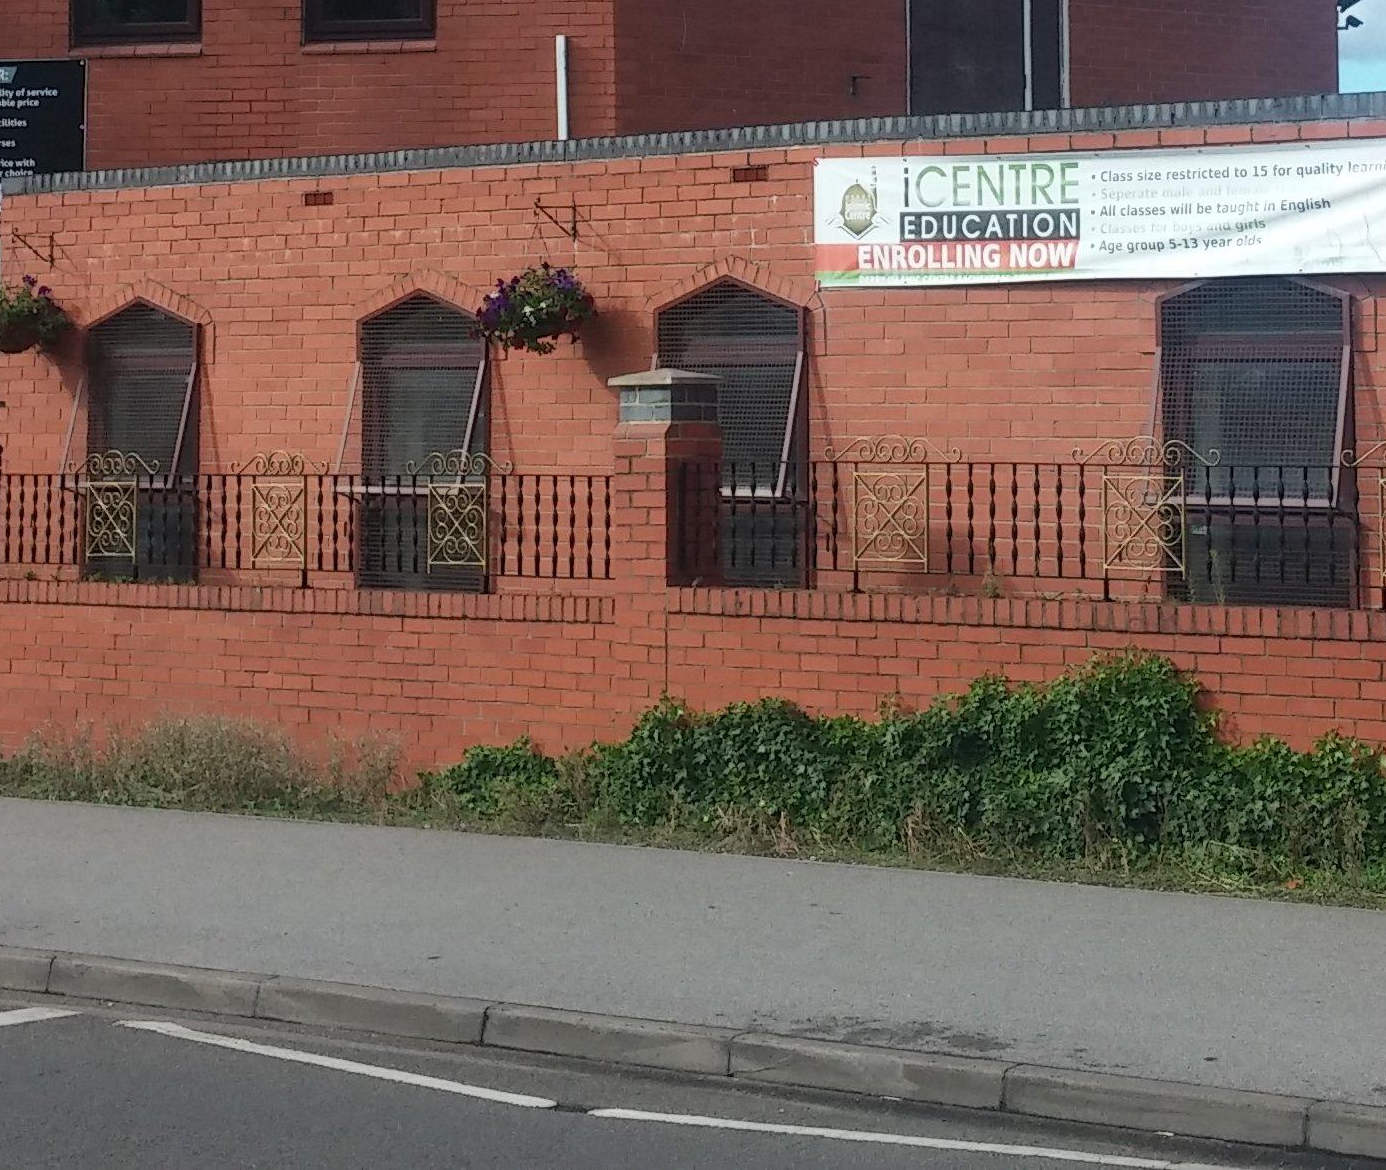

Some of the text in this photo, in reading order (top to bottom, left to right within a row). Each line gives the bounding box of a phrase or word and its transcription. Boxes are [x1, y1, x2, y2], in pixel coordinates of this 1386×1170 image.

[15, 87, 25, 97] of
[26, 87, 58, 97] service
[17, 98, 40, 109] price
[15, 158, 36, 167] with
[1100, 170, 1133, 182] Class
[1137, 169, 1162, 181] size
[1166, 167, 1230, 180] restricted
[1234, 168, 1248, 178] to
[1252, 165, 1268, 177] 15
[1272, 164, 1292, 177] for
[1296, 162, 1343, 177] quality
[4, 169, 34, 178] choice
[903, 162, 1079, 208] iCENTRE
[1099, 198, 1331, 217] All classes will be taught in English
[903, 212, 1077, 240] EDUCATION
[1173, 221, 1202, 235] boys
[1207, 221, 1231, 231] and
[1235, 218, 1267, 232] girls
[1099, 235, 1262, 254] Age group 5-13 year olds
[857, 241, 1074, 270] ENROLLING NOW
